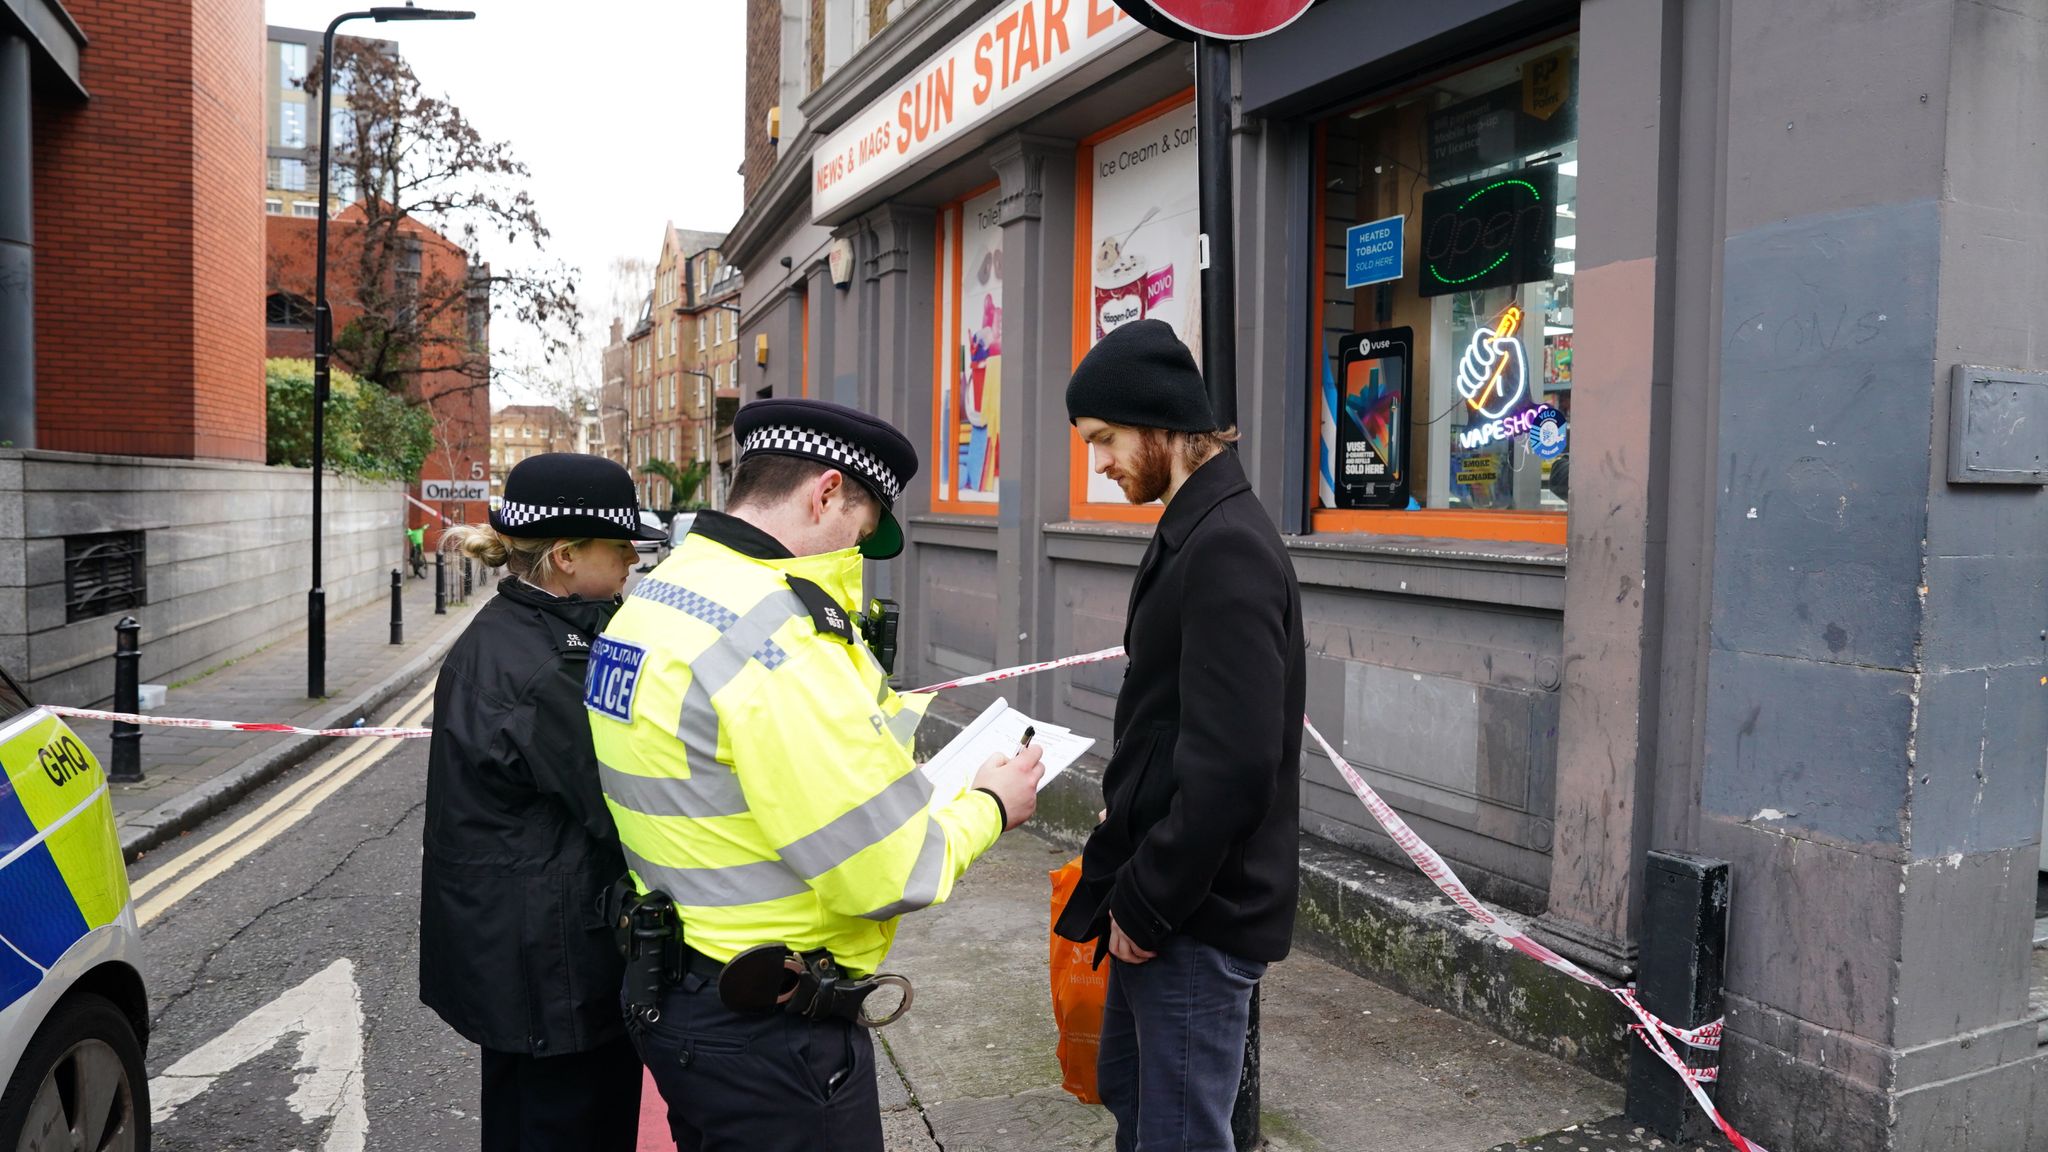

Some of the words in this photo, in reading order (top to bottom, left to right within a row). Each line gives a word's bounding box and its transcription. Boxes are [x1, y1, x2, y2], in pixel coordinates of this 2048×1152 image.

[816, 155, 843, 195] NEWS
[847, 146, 854, 173] &
[859, 121, 890, 167] MAGS
[897, 58, 954, 155] SUN
[973, 0, 1070, 106] STAR
[1099, 160, 1116, 179] Ice
[1118, 142, 1158, 170] Cream
[1161, 134, 1171, 153] &
[1359, 228, 1391, 244] HEATED
[1355, 240, 1394, 257] TOBACCO
[1355, 259, 1375, 272] SOLD
[1374, 250, 1395, 267] HERE
[1147, 274, 1172, 299] NOVO
[1538, 410, 1556, 420] VELO
[1346, 441, 1366, 452] VUSE
[471, 461, 484, 480] 5
[1345, 464, 1364, 475] SOLD
[1364, 464, 1385, 475] HERE
[1463, 459, 1490, 468] SMOKE
[1457, 472, 1497, 482] GRENADES
[426, 484, 484, 499] Oneder
[824, 607, 839, 618] CE
[38, 735, 90, 787] GHQ
